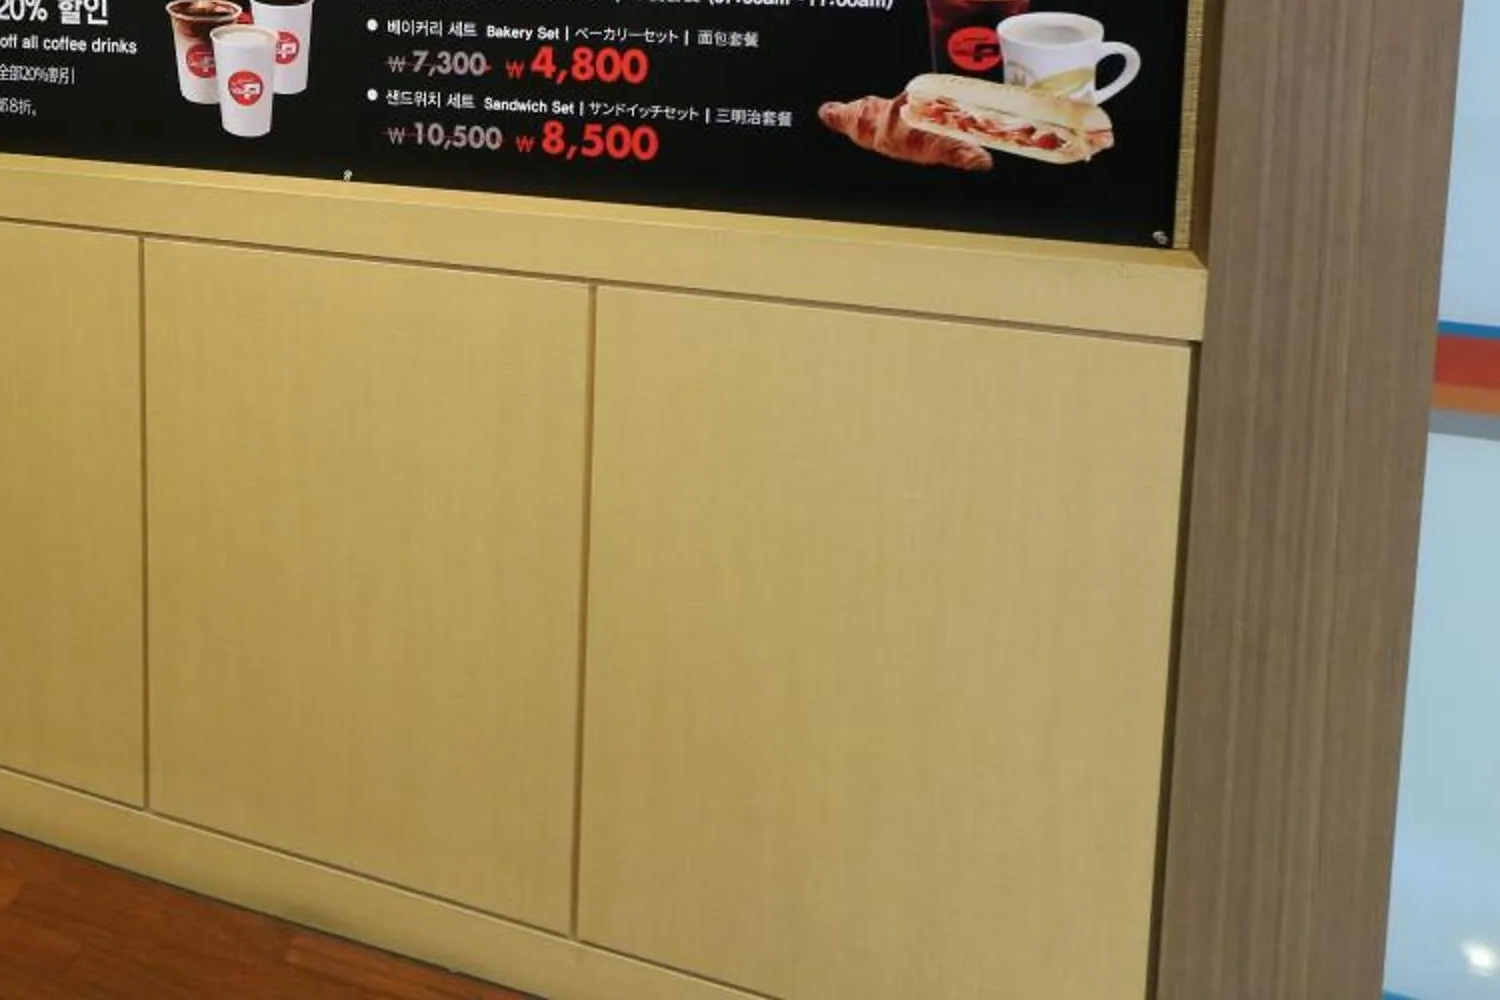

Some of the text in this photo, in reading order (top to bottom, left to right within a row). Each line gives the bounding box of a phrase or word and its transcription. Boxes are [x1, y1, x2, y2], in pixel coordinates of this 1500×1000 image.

[387, 19, 561, 41] 베이커리 세트 Bakery Set
[0, 32, 18, 49] off
[22, 34, 39, 50] all
[43, 35, 88, 52] coffee
[92, 38, 138, 55] drinks
[385, 89, 575, 115] 샌드위치 세트 Sandwich Set
